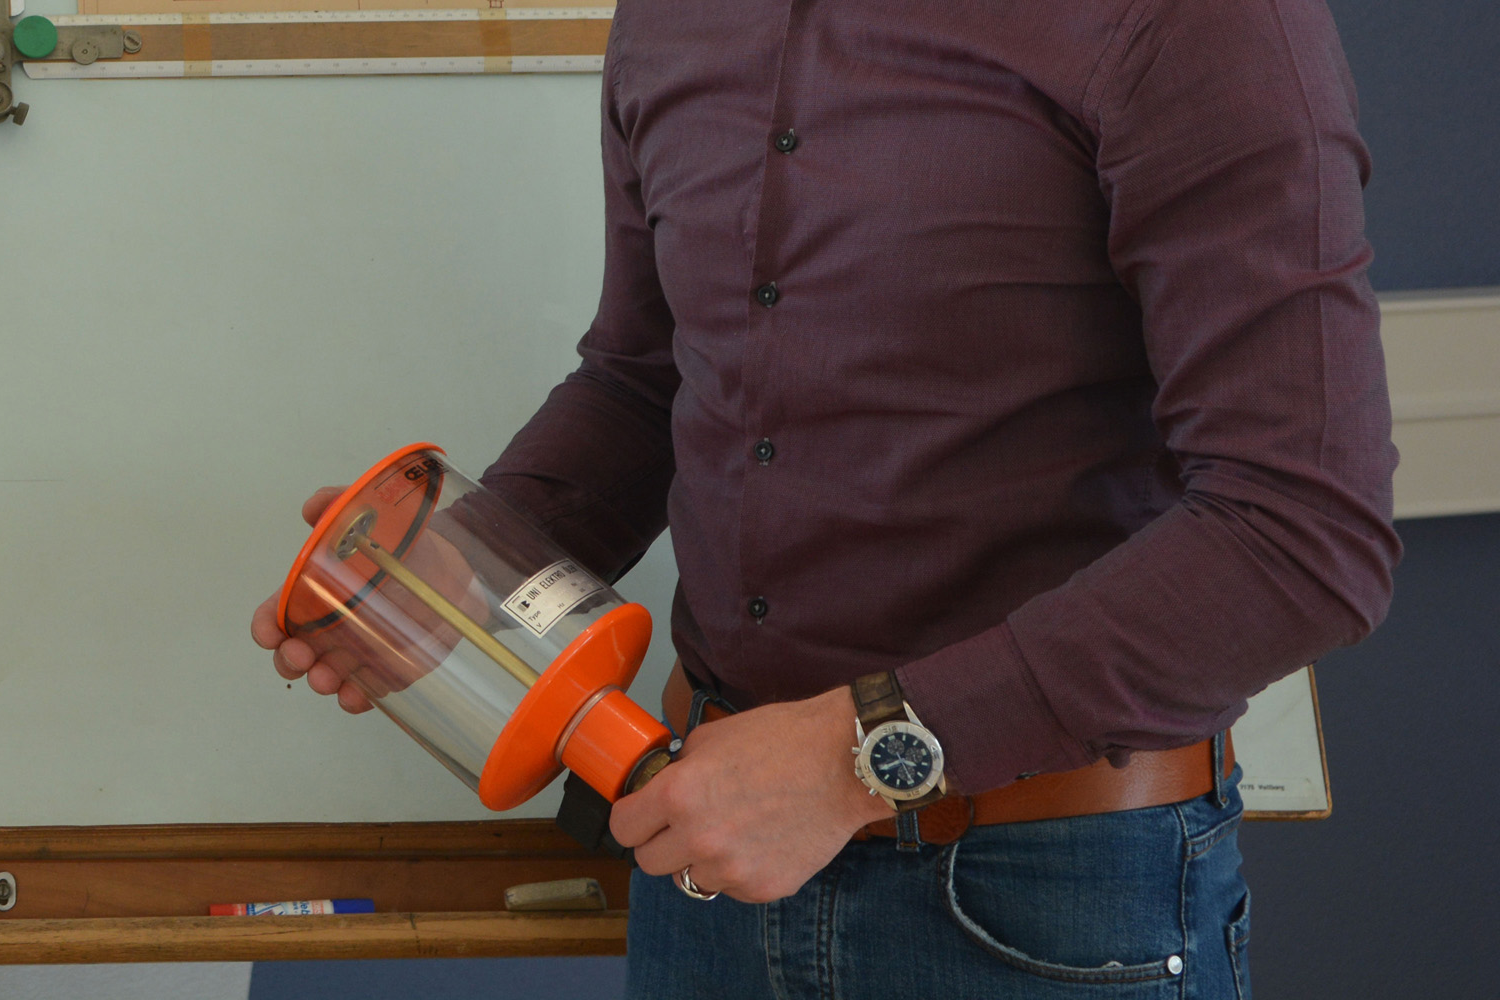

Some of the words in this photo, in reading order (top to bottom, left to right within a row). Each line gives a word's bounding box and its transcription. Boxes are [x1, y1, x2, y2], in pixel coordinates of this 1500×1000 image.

[526, 587, 542, 600] UNI
[539, 570, 566, 590] ELEKTRO
[528, 610, 542, 621] Type
